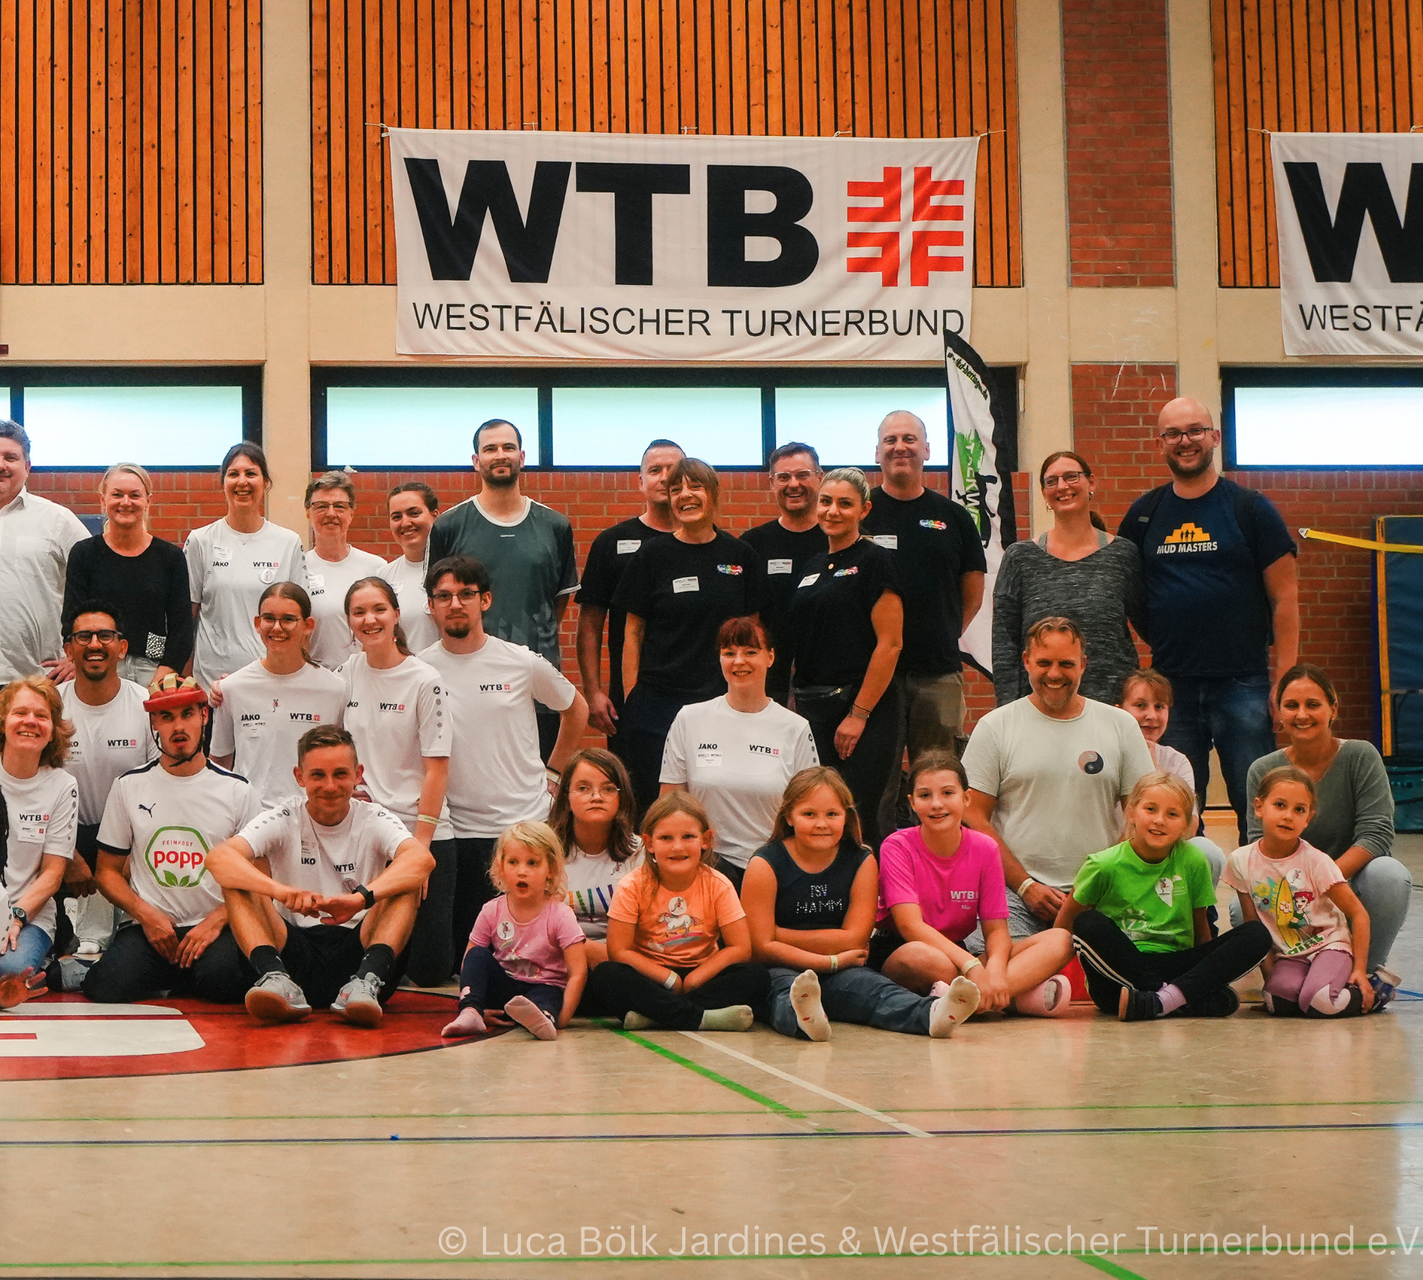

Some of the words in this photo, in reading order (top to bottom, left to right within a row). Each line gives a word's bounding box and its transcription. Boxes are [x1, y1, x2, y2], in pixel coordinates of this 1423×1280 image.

[403, 157, 820, 287] WTB
[412, 301, 711, 336] WESTFÄLISCHER
[721, 309, 964, 337] TURNERBUND
[1298, 301, 1423, 332] WESTF
[1156, 544, 1176, 554] MUD
[1178, 541, 1218, 553] MASTERS
[380, 702, 397, 710] WTB
[290, 713, 312, 721] WTB
[749, 744, 771, 754] WTB
[154, 850, 203, 869] popp
[334, 863, 354, 872] WTB
[811, 884, 827, 898] TSV
[950, 890, 975, 900] WTB
[796, 899, 843, 914] HAMM
